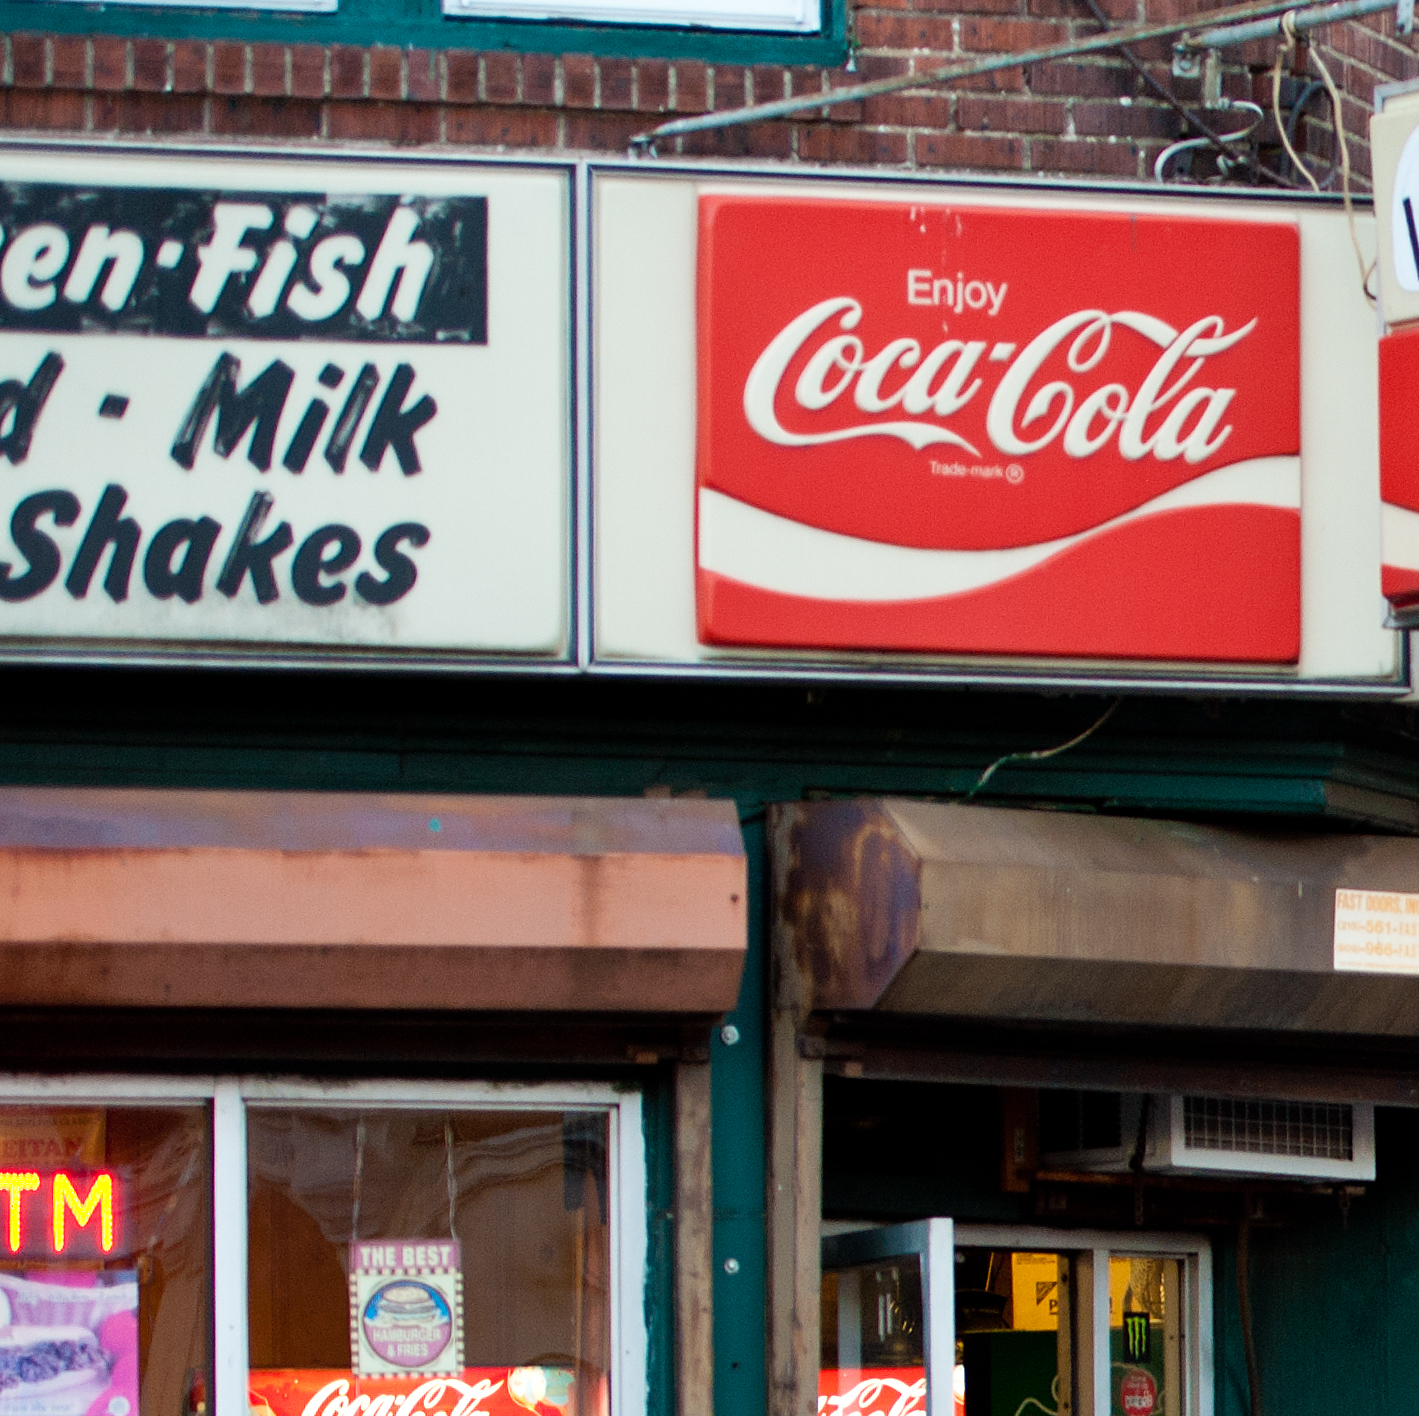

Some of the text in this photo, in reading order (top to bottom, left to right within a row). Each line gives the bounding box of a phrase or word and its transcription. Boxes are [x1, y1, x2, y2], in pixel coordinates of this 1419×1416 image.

[907, 269, 1007, 316] Enjoy
[170, 350, 438, 478] Milk
[744, 296, 1257, 463] Coca-Cola
[0, 483, 431, 605] Shakes
[360, 1245, 451, 1267] THE BEST
